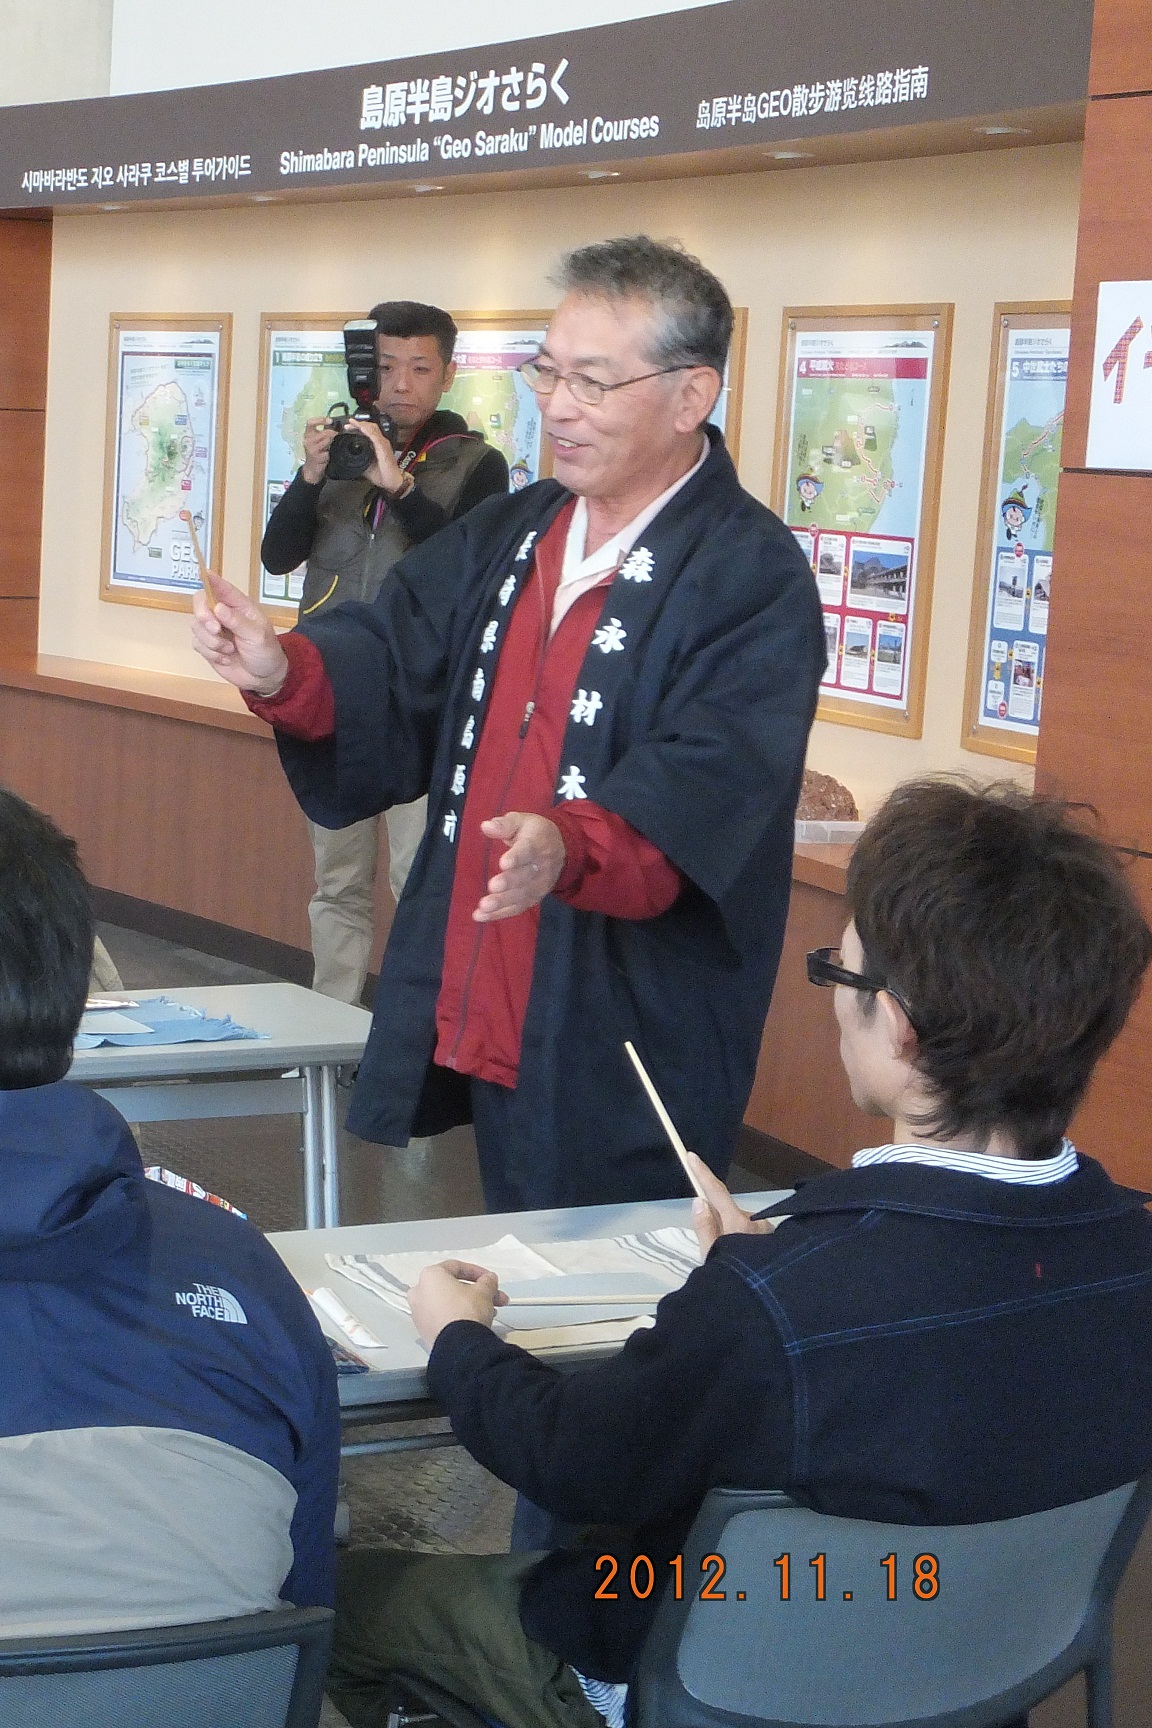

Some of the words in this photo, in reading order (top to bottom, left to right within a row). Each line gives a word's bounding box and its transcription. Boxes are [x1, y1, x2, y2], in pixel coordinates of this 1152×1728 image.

[360, 57, 571, 131] 島原半島ジオさらく
[696, 65, 929, 130] 岛原半岛GEO散步游览线路指南
[280, 150, 355, 175] Shimabara
[358, 138, 429, 167] Peninsula
[540, 119, 587, 149] Model
[591, 114, 660, 143] Courses
[21, 167, 88, 193] 시마바라반도
[91, 165, 114, 189] 지오
[116, 162, 153, 187] 사라쿠
[154, 159, 189, 184] 코스별
[192, 155, 251, 182] 투어가이드
[1011, 361, 1020, 378] 5
[175, 1292, 224, 1308] NORTH
[192, 1283, 219, 1295] THE
[192, 1305, 225, 1321] FACE
